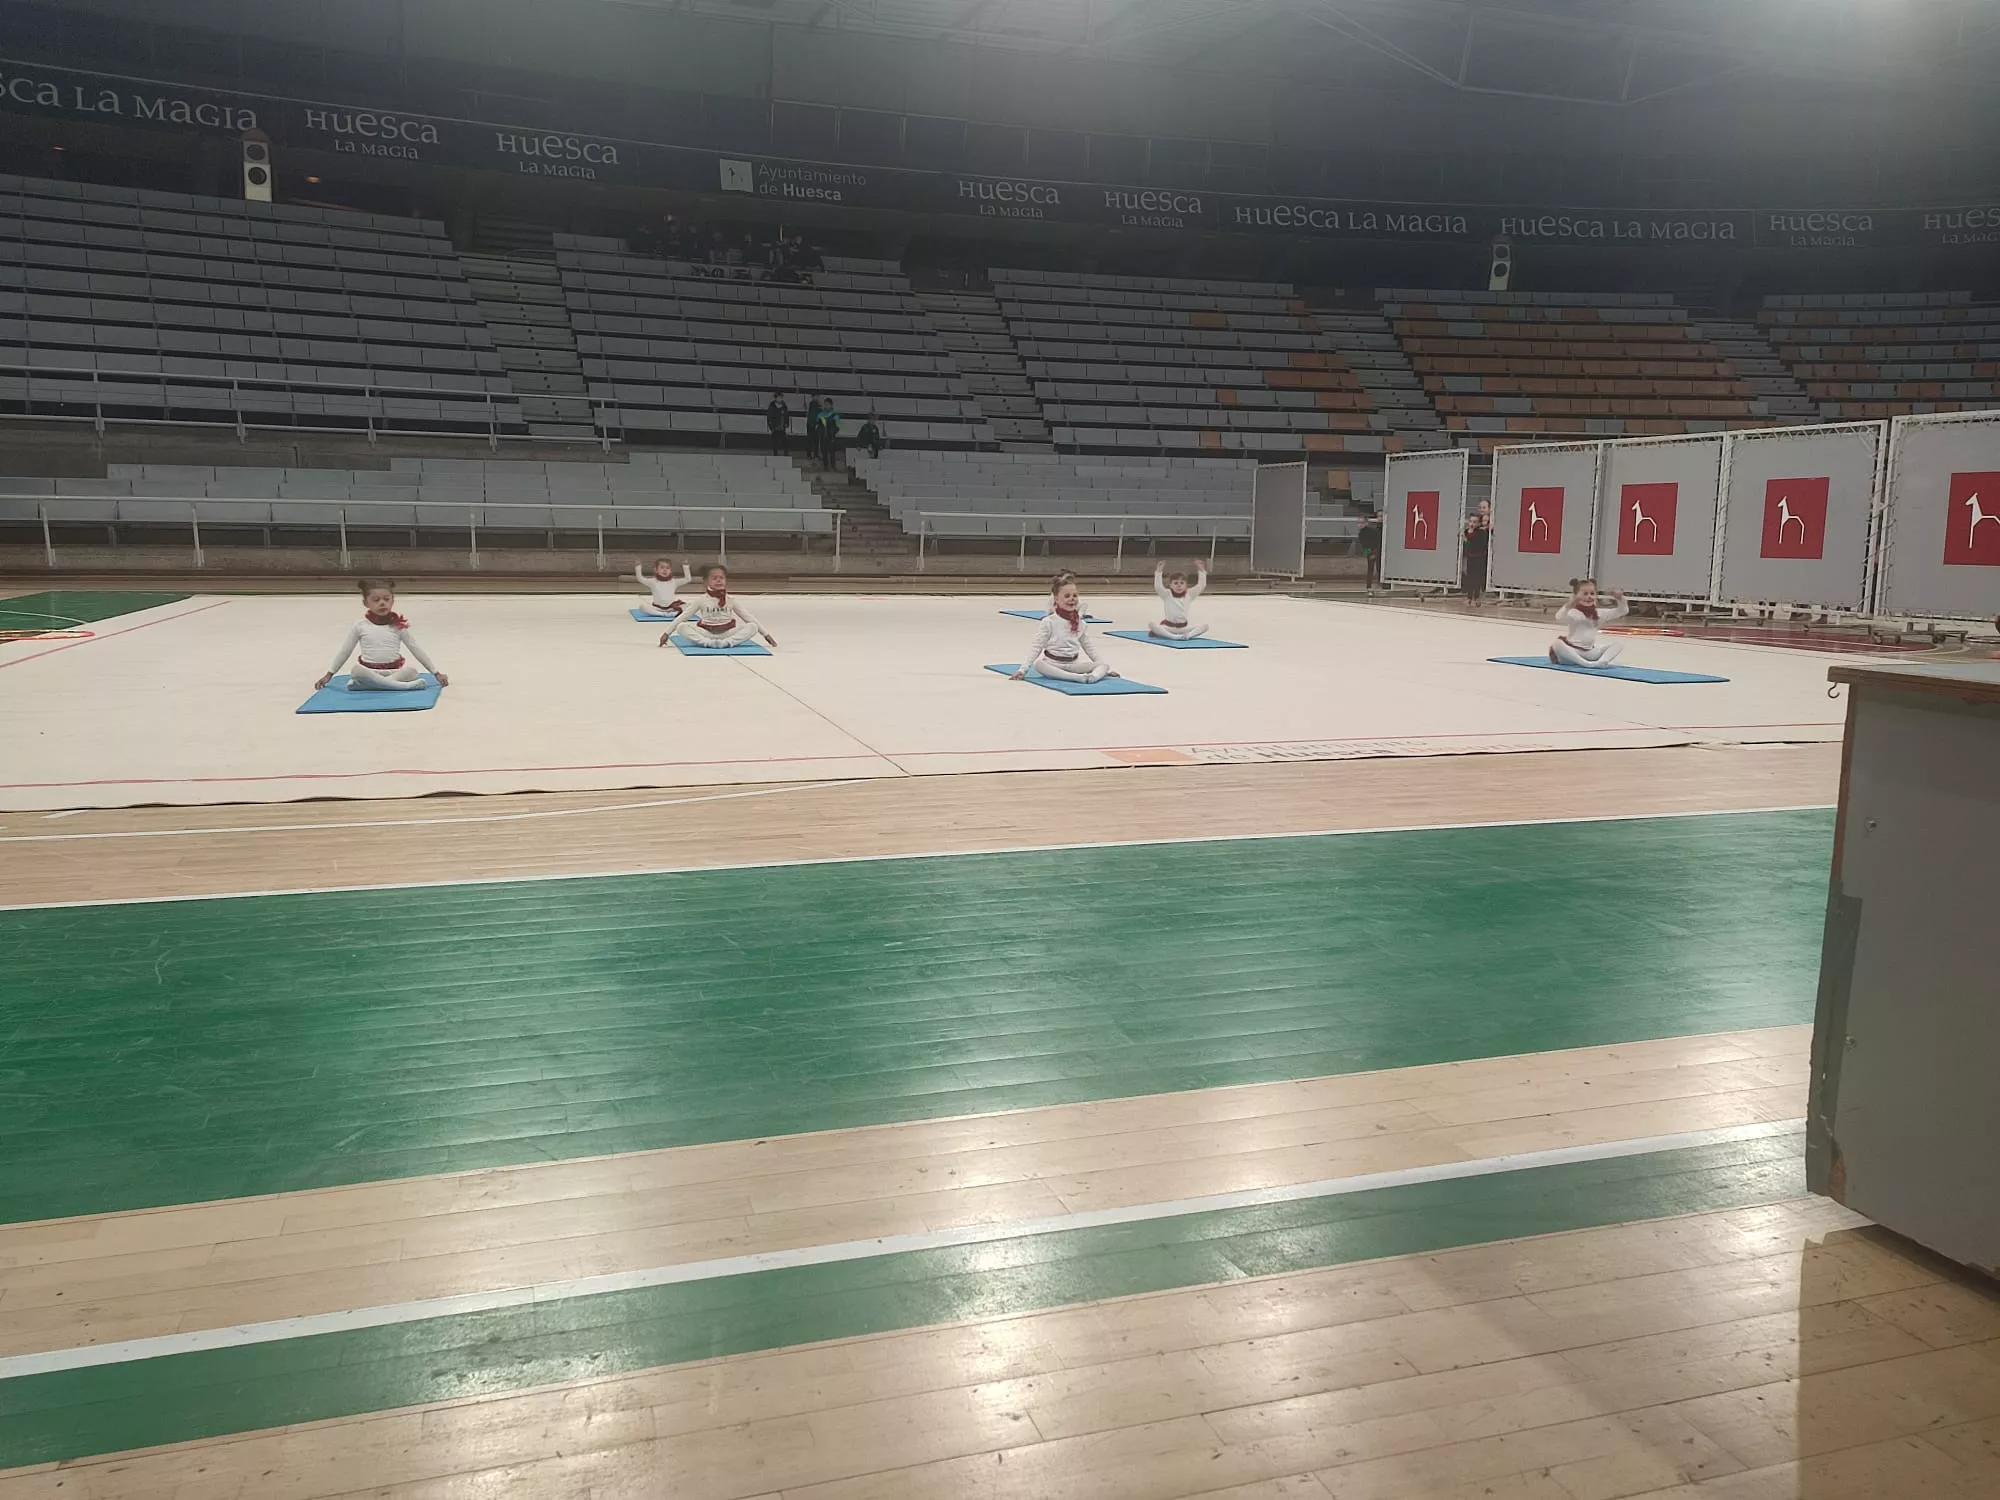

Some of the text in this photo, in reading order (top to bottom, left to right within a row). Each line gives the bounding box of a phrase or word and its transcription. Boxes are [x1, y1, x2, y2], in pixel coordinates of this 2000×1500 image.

[759, 163, 867, 186] Ayuntamiento
[759, 181, 842, 201] de Huesca
